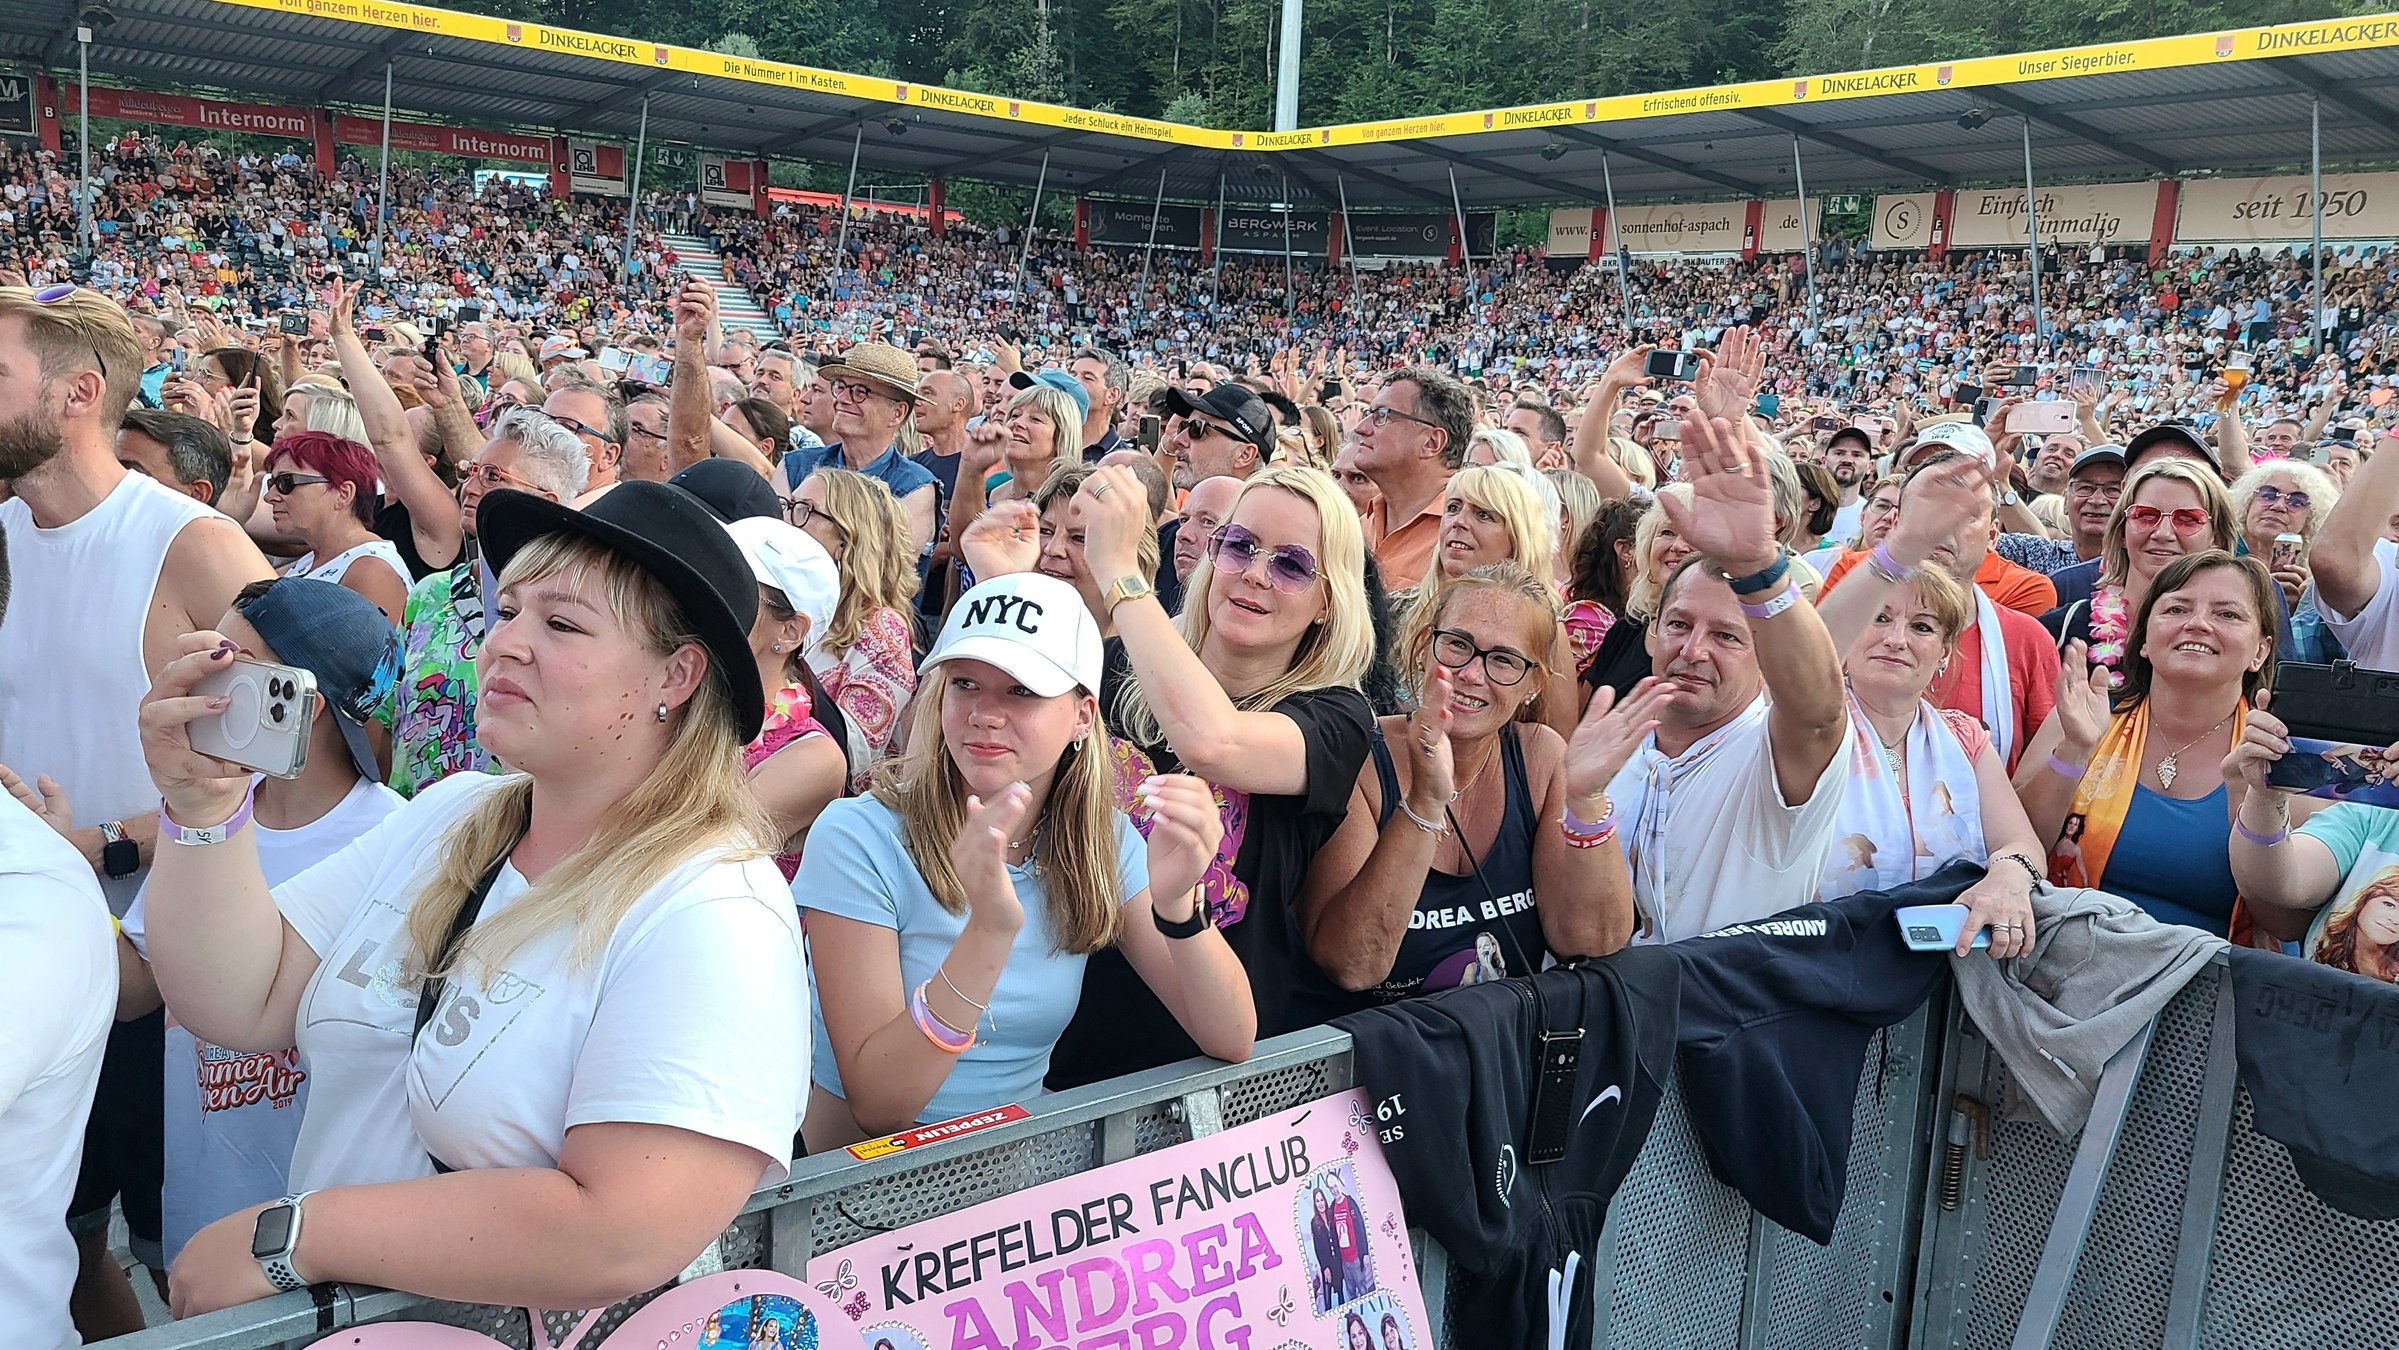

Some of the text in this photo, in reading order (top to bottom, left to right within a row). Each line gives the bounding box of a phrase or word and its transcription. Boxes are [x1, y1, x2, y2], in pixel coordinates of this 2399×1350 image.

[307, 0, 358, 16] ganzem
[362, 5, 408, 23] Herzen
[412, 12, 440, 28] hier.
[539, 30, 639, 59] DINKELACKER
[2257, 22, 2399, 50] DINKELACKER
[2018, 51, 2136, 75] Unser Siegerbier.
[724, 61, 740, 74] Die
[744, 64, 786, 81] Nummer
[796, 72, 808, 84] im
[811, 74, 847, 90] Kasten.
[1822, 72, 1919, 94] DINKELACKER
[44, 106, 54, 118] B
[921, 89, 996, 113] DINKELACKER
[1643, 91, 1741, 112] Erfrischend offensiv.
[200, 105, 306, 132] Internorm
[1063, 113, 1174, 139] Jeder Schluck ein Heimspiel.
[1504, 107, 1573, 125] DINKELACKER
[1257, 134, 1313, 147] DINKELACKER
[1362, 122, 1446, 139] Von ganzem Herzen hier.
[453, 134, 546, 159] Internorm
[1114, 211, 1170, 224] Momete
[1977, 193, 2055, 219] Einfach
[2232, 194, 2283, 219] seit
[1228, 218, 1318, 231] BERGWERK
[1381, 225, 1418, 233] Location
[1555, 225, 1588, 236] www.
[1621, 218, 1730, 236] sonnenhof-aspach
[1778, 217, 1798, 230] .de
[961, 594, 1044, 634] NYC
[1407, 887, 1536, 930] DREA BERG
[1752, 919, 1827, 937] ANDREA
[245, 1066, 305, 1102] Air
[272, 1097, 293, 1110] 2019
[915, 1111, 1008, 1142] ZEPPELIN
[881, 1135, 1310, 1310] KREFELDER FANCLUB
[943, 1211, 1283, 1350] ANDREA
